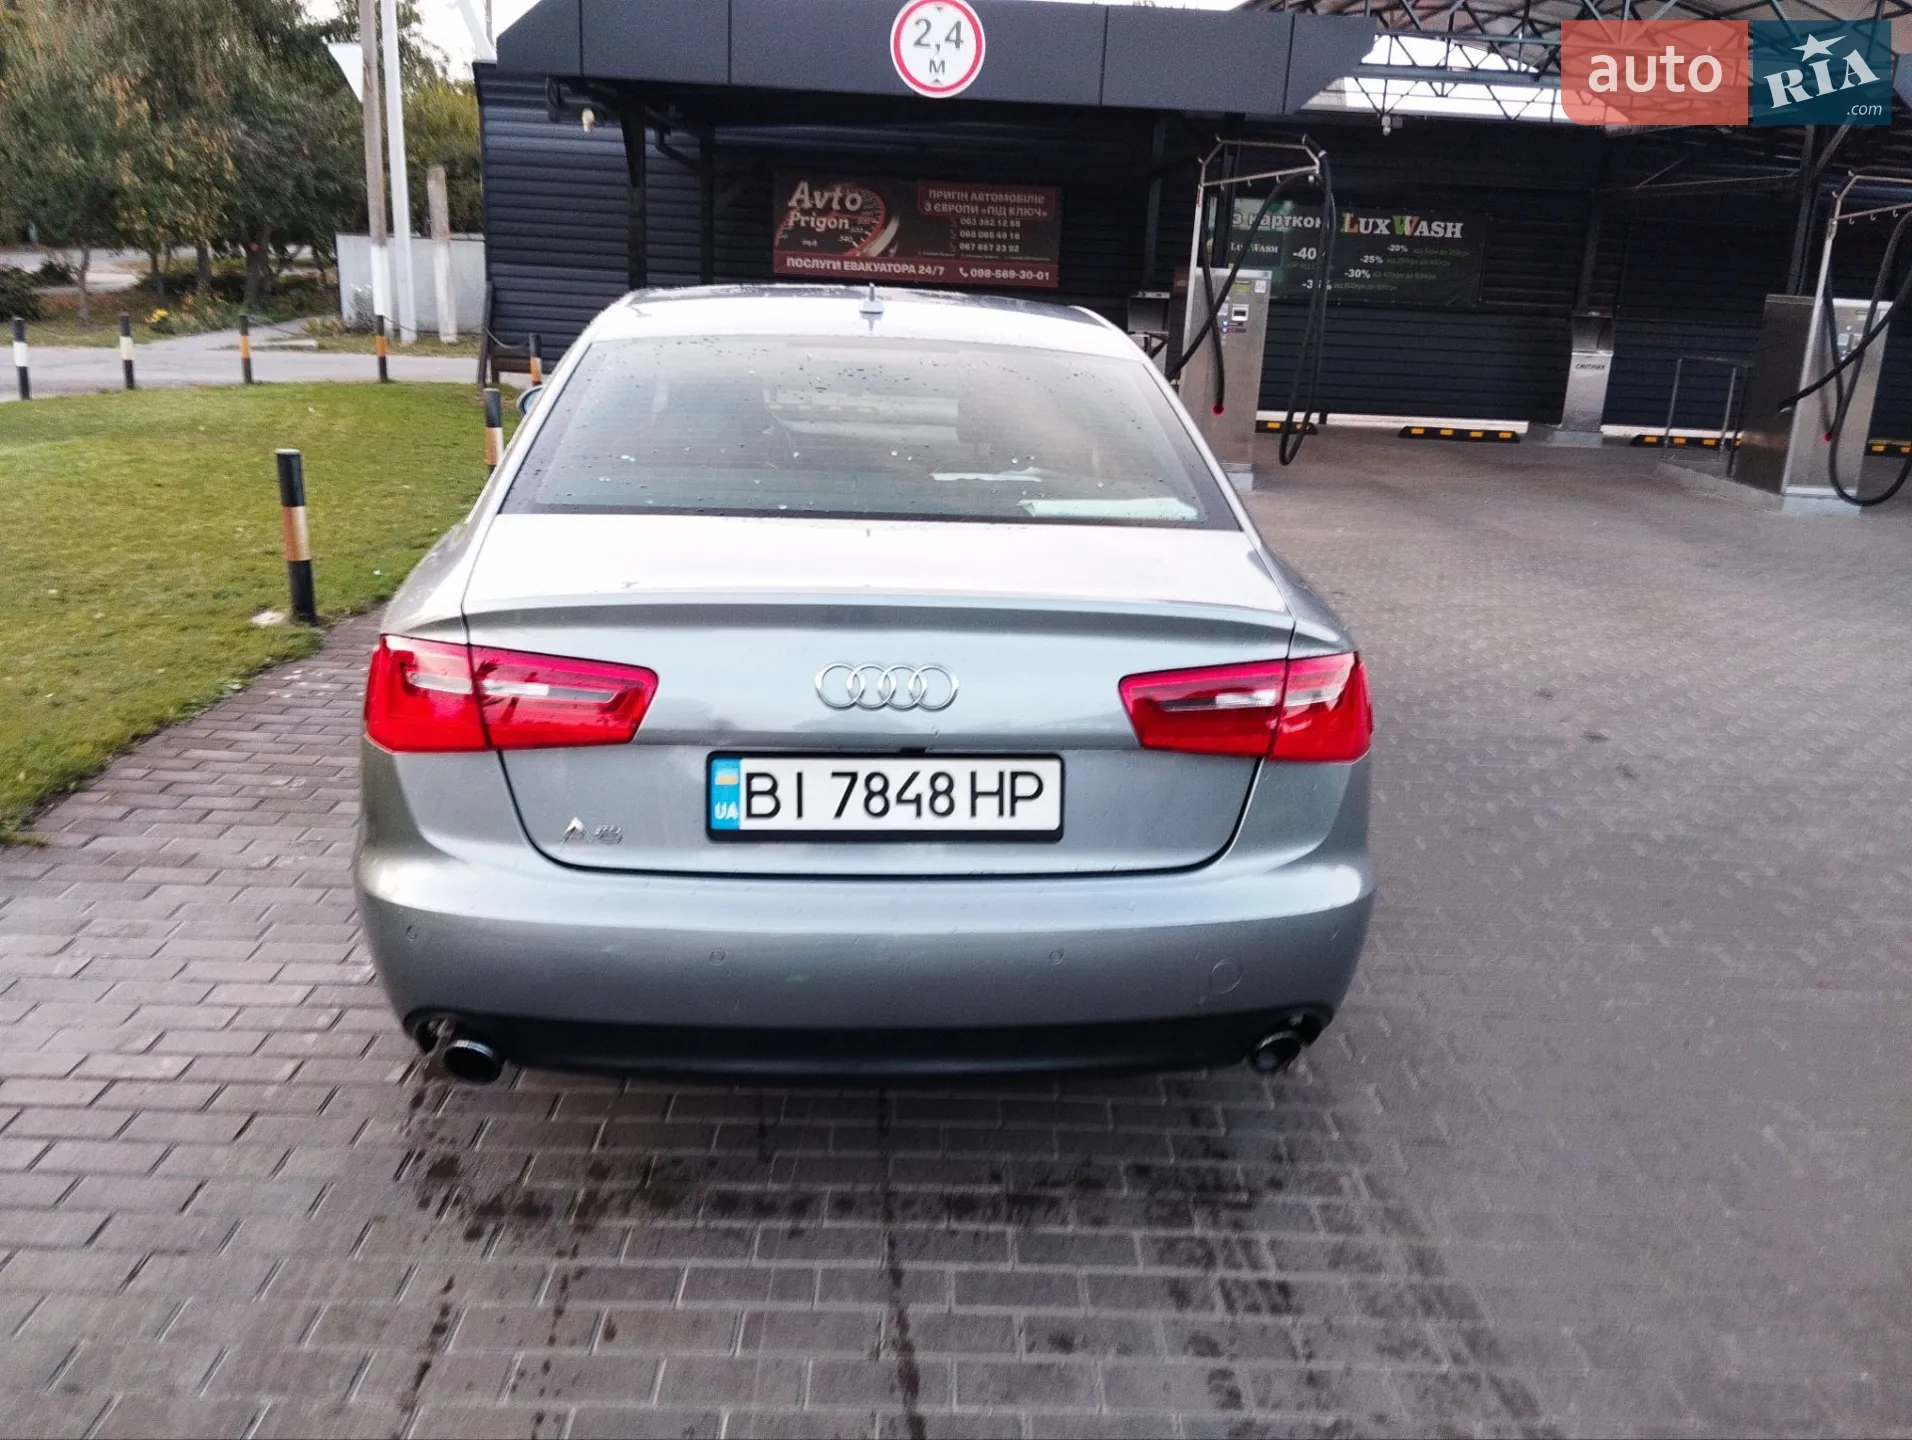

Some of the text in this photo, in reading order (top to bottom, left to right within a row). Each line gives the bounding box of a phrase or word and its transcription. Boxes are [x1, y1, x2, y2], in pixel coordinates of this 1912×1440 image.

[913, 18, 964, 53] 2,4
[787, 180, 863, 212] Avto
[788, 208, 851, 232] Prigon
[1293, 247, 1326, 260] -40
[786, 256, 945, 276] ПОСЛУГИ ЕВАКУАТОРА 24/7
[970, 267, 1050, 281] 098-569-30-01
[1344, 268, 1371, 279] -30%
[830, 770, 955, 819] 7848
[714, 801, 740, 821] UA
